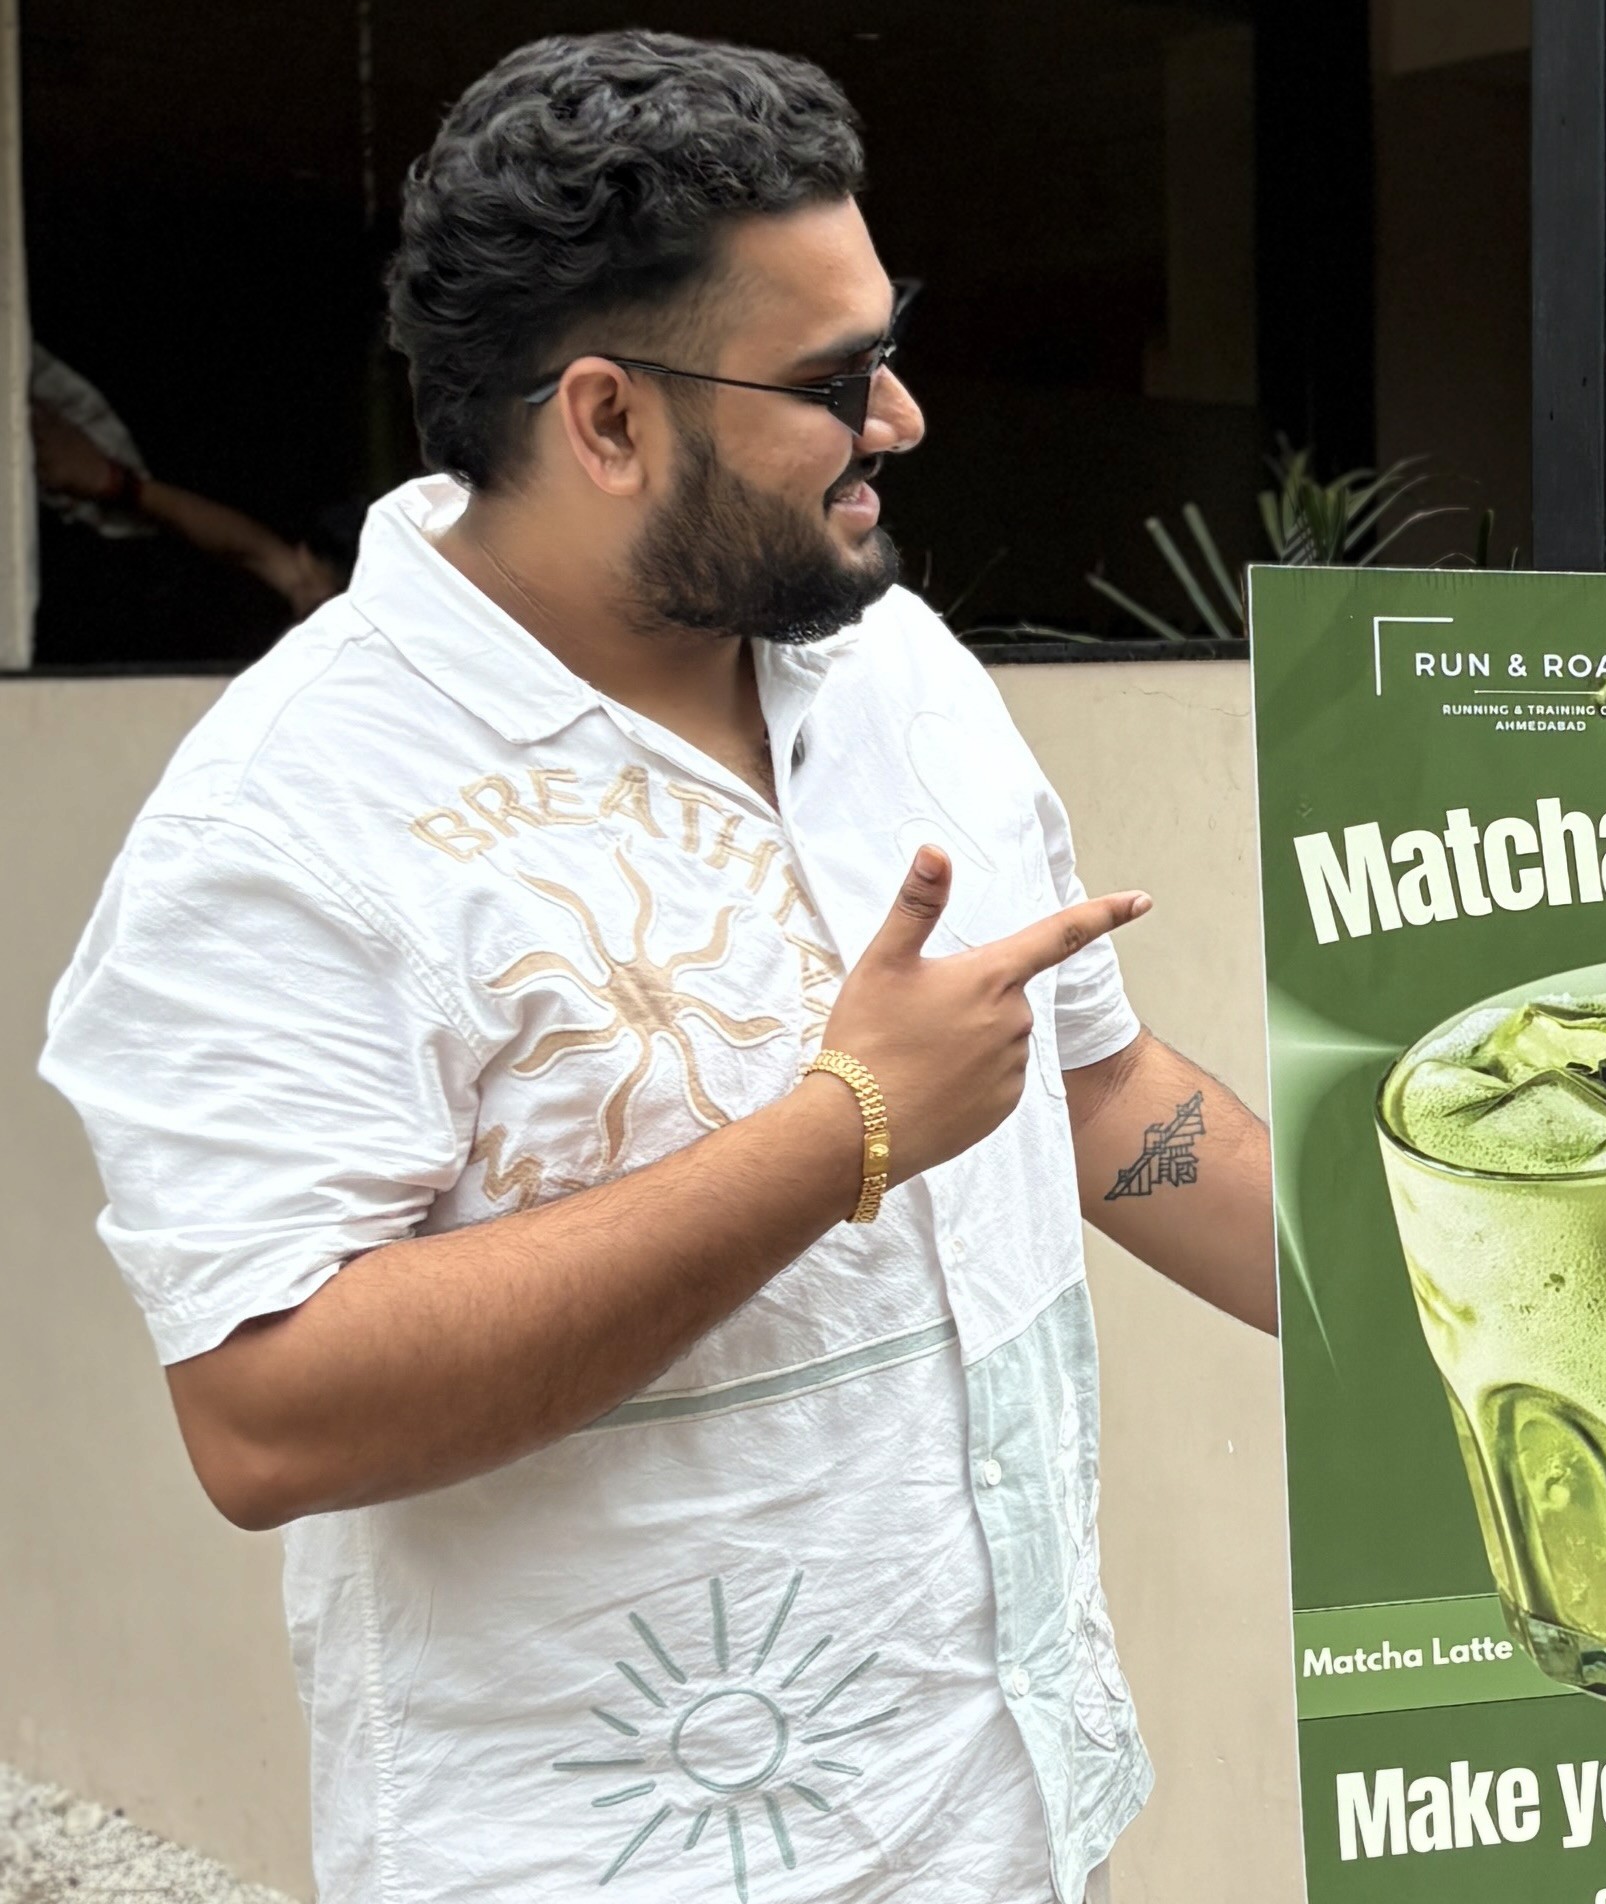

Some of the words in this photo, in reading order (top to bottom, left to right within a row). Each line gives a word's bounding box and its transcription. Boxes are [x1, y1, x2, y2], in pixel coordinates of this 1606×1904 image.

[1415, 652, 1490, 677] RUN
[1507, 653, 1528, 677] &
[1442, 704, 1509, 715] RUNNING
[1514, 705, 1523, 715] &
[1527, 704, 1596, 716] TRAINING
[1495, 720, 1587, 732] AHMEDABAD
[1303, 1640, 1423, 1678] Matcha
[1432, 1636, 1514, 1665] Latte
[1336, 1760, 1541, 1861] Make
